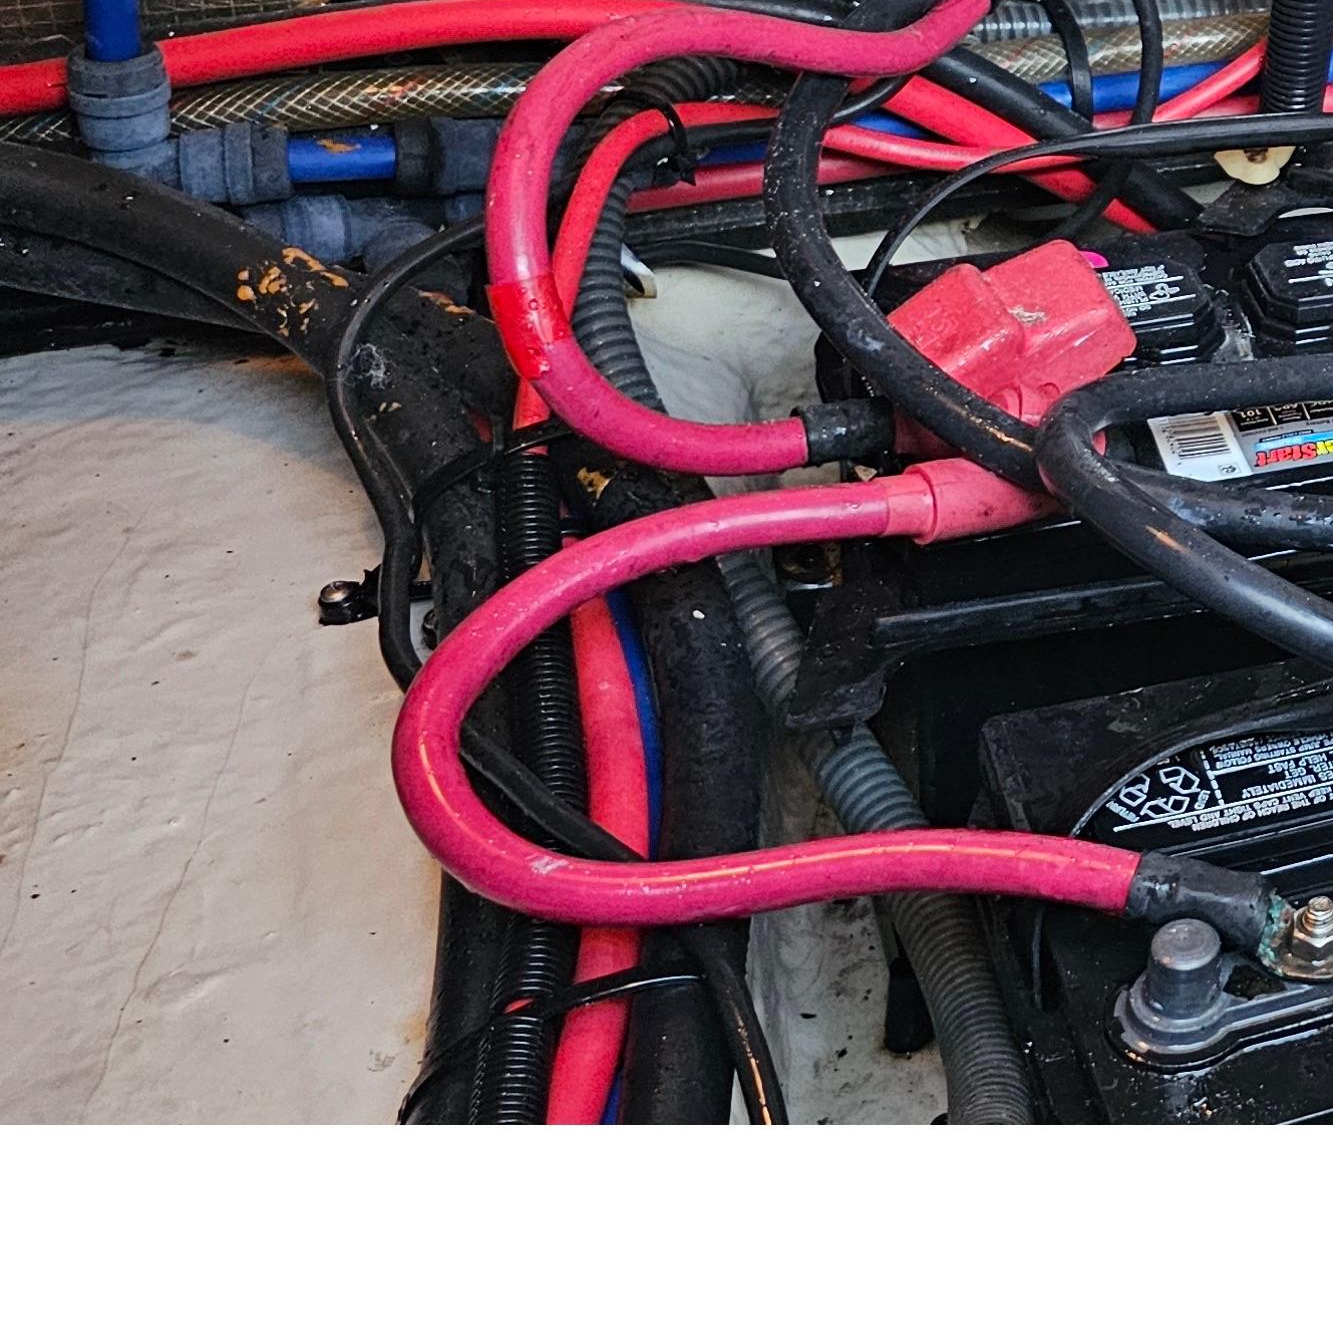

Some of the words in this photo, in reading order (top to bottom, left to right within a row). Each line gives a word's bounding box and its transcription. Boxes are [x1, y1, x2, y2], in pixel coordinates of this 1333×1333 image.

[1267, 759, 1295, 773] FAST
[1297, 752, 1326, 766] HELP
[1283, 765, 1306, 779] GET
[1240, 774, 1315, 798] IMMEDIATELY
[1252, 796, 1279, 810] CAPS
[1280, 790, 1306, 803] VENT
[1291, 797, 1309, 809] THE
[1312, 794, 1326, 804] OF
[1198, 810, 1220, 823] AND
